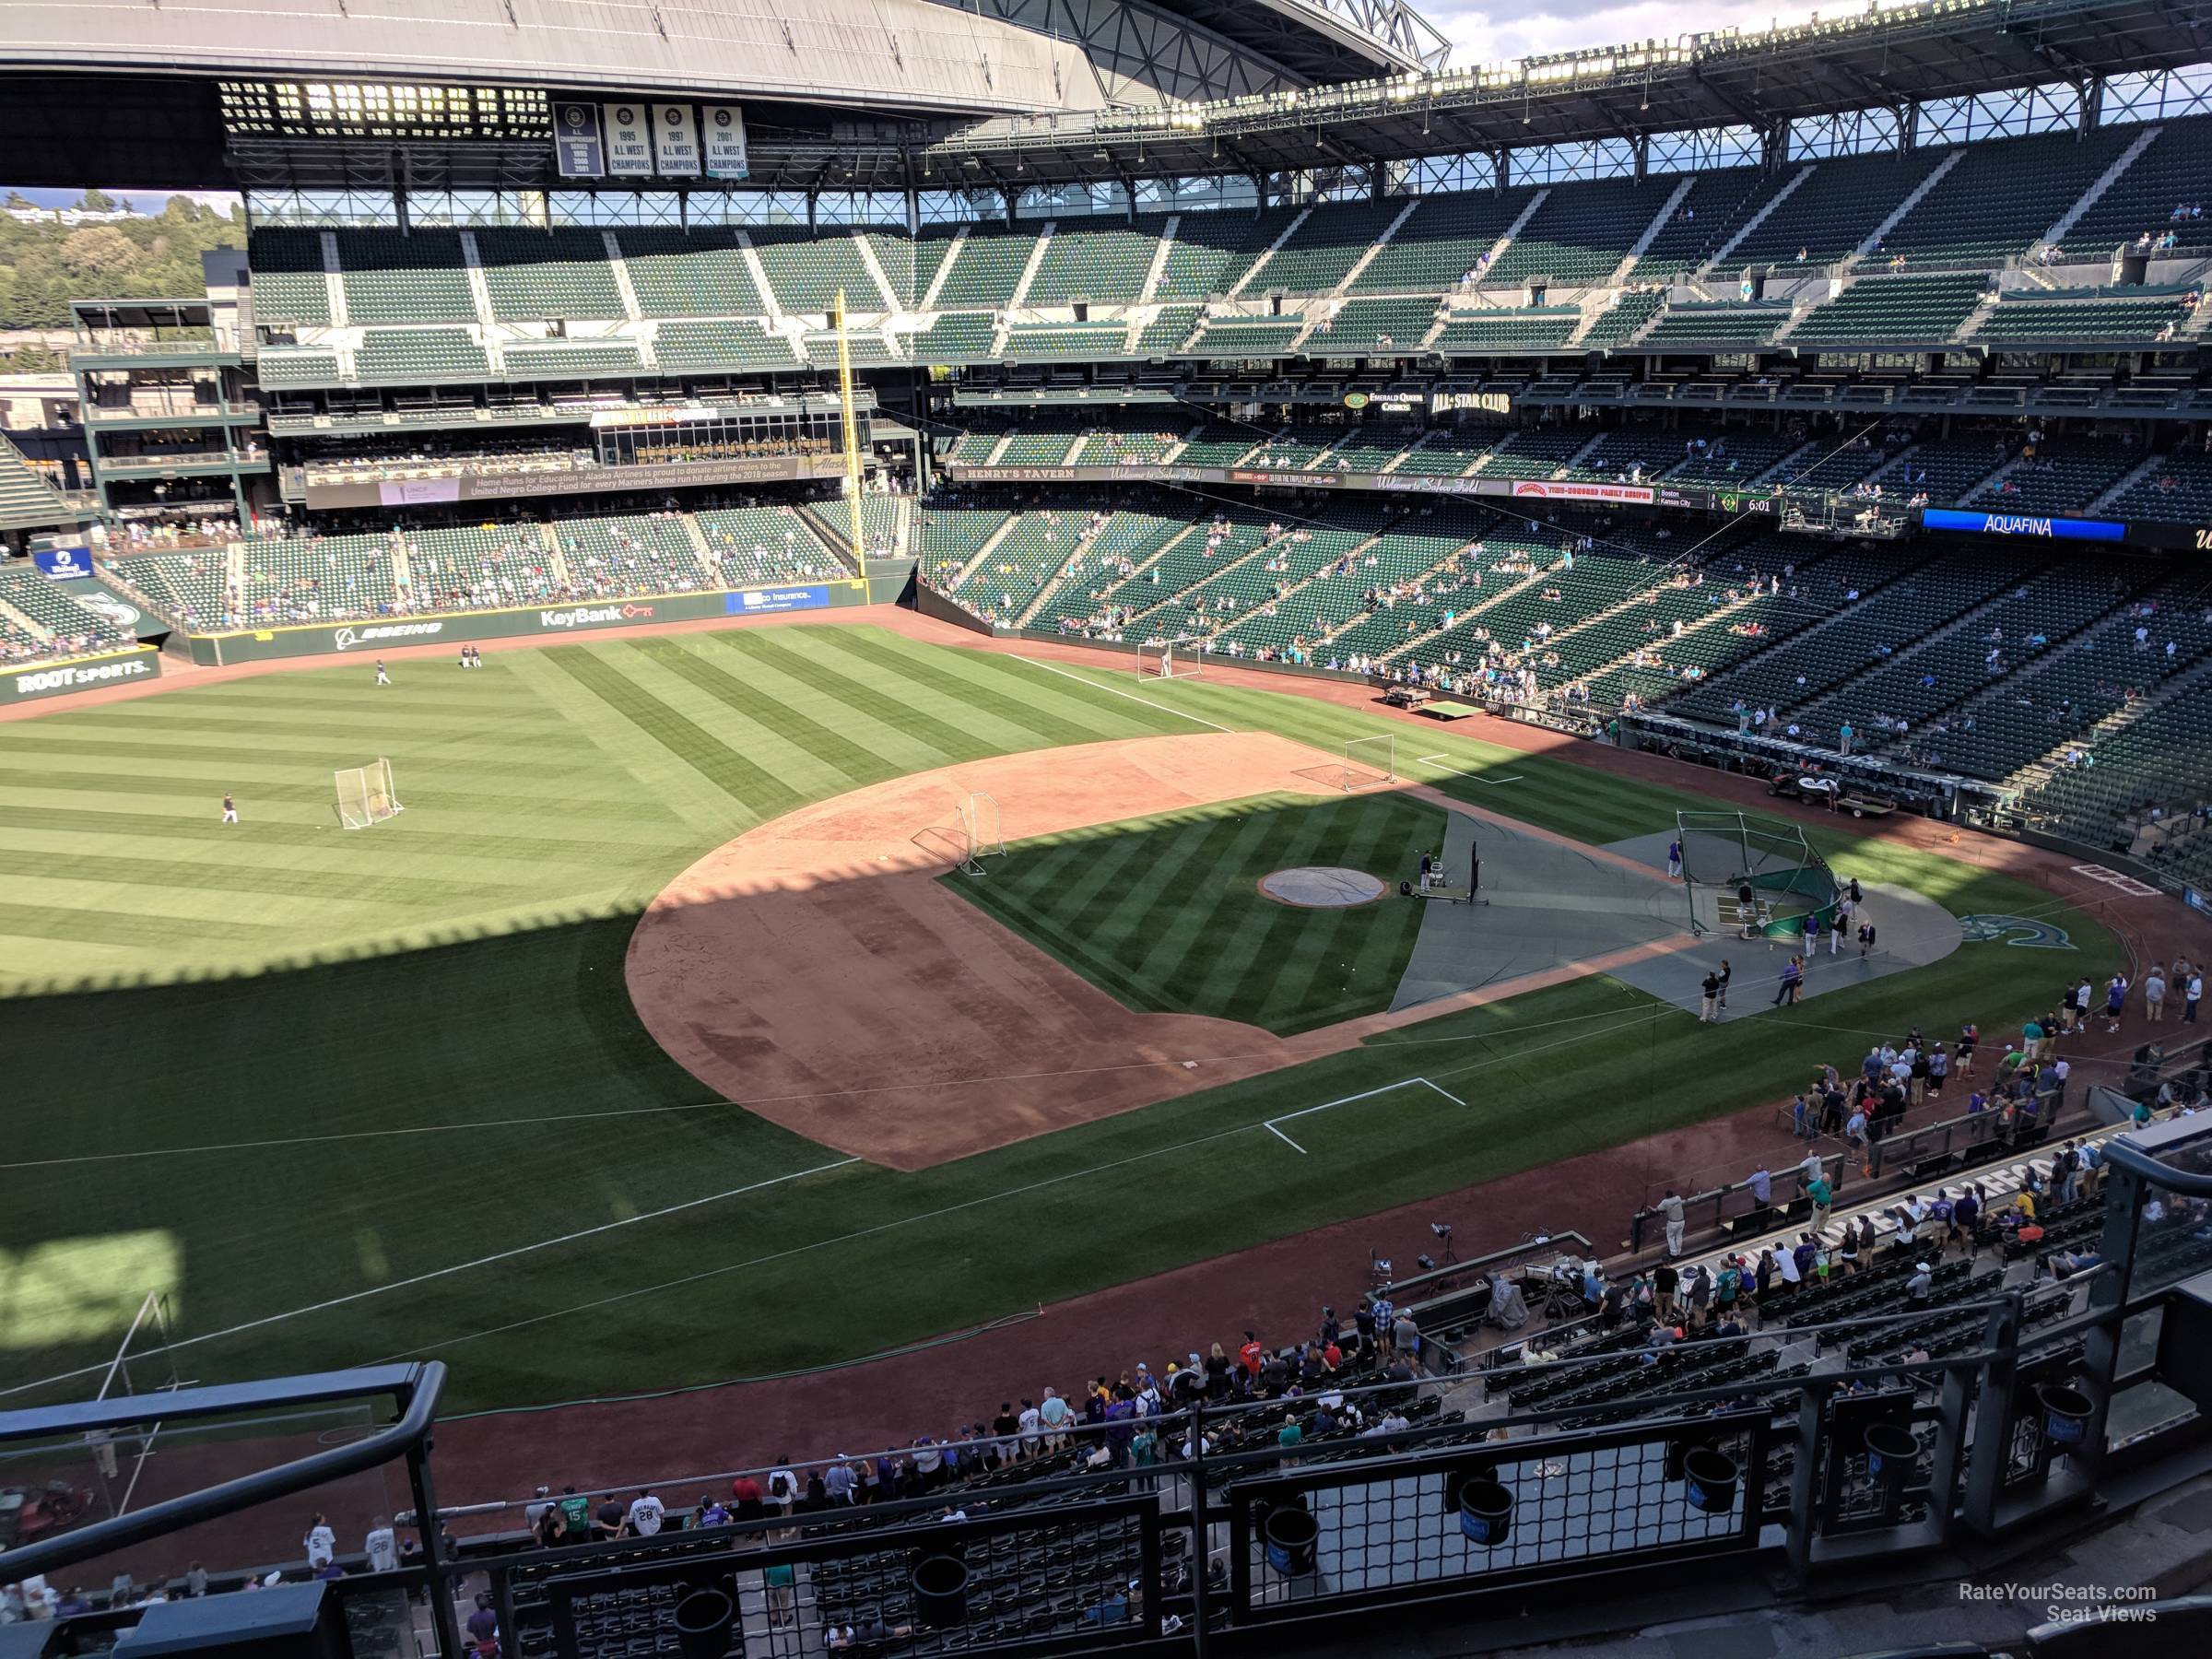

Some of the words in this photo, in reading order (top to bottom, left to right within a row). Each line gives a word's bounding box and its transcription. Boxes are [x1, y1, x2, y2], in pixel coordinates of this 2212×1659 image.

[619, 131, 636, 142] 1995
[668, 131, 684, 142] 1997
[717, 132, 734, 142] 2001
[615, 145, 626, 155] A.L.
[627, 145, 644, 155] WEST
[663, 146, 674, 155] A.L.
[675, 146, 692, 156] WEST
[712, 146, 723, 155] A.L.
[724, 146, 741, 156] WEST
[612, 159, 651, 171] CHAMPIONS
[661, 159, 698, 171] CHAMPIONS
[710, 159, 746, 170] CHAMPIONS
[1481, 394, 1511, 414] CLUB
[476, 477, 501, 488] Home
[502, 476, 524, 486] Runs
[525, 475, 537, 484] for
[538, 472, 579, 483] Education
[584, 471, 612, 480] Alaska
[613, 469, 643, 479] Airlines
[644, 468, 652, 477] is
[653, 466, 676, 478] proud
[677, 466, 684, 475] to
[685, 465, 712, 475] donate
[712, 463, 737, 473] airline
[738, 462, 759, 471] miles
[759, 462, 769, 470] to
[769, 461, 782, 470] the
[967, 469, 1019, 478] HENRY'S
[1023, 469, 1075, 478] TAVERN
[1111, 466, 1145, 479] Welcome
[1155, 467, 1181, 480] Safeco
[1182, 467, 1202, 480] Field
[471, 486, 498, 496] United
[500, 484, 525, 496] Negro
[526, 482, 558, 494] College
[558, 480, 579, 490] Fund
[580, 480, 592, 489] for
[594, 479, 618, 490] every
[618, 477, 653, 488] Mariners
[654, 475, 677, 485] home
[677, 475, 692, 484] run
[692, 473, 702, 482] hit
[703, 470, 728, 483] during
[729, 470, 742, 480] the
[761, 470, 788, 479] season
[1377, 476, 1411, 489] Welcome
[1413, 481, 1420, 490] to
[1422, 477, 1452, 492] Safeco
[1453, 478, 1480, 493] Field
[1661, 489, 1679, 498] Boston
[1661, 499, 1679, 507] Kansas
[1679, 500, 1691, 508] City
[1748, 499, 1771, 512] 6:01
[1983, 513, 2053, 538] AQUAFINA
[540, 606, 623, 627] KeyBank
[361, 622, 443, 639] BOEING
[17, 667, 76, 693] ROOT
[568, 1511, 582, 1522] 15
[639, 1511, 653, 1522] 28
[312, 1538, 321, 1549] 5
